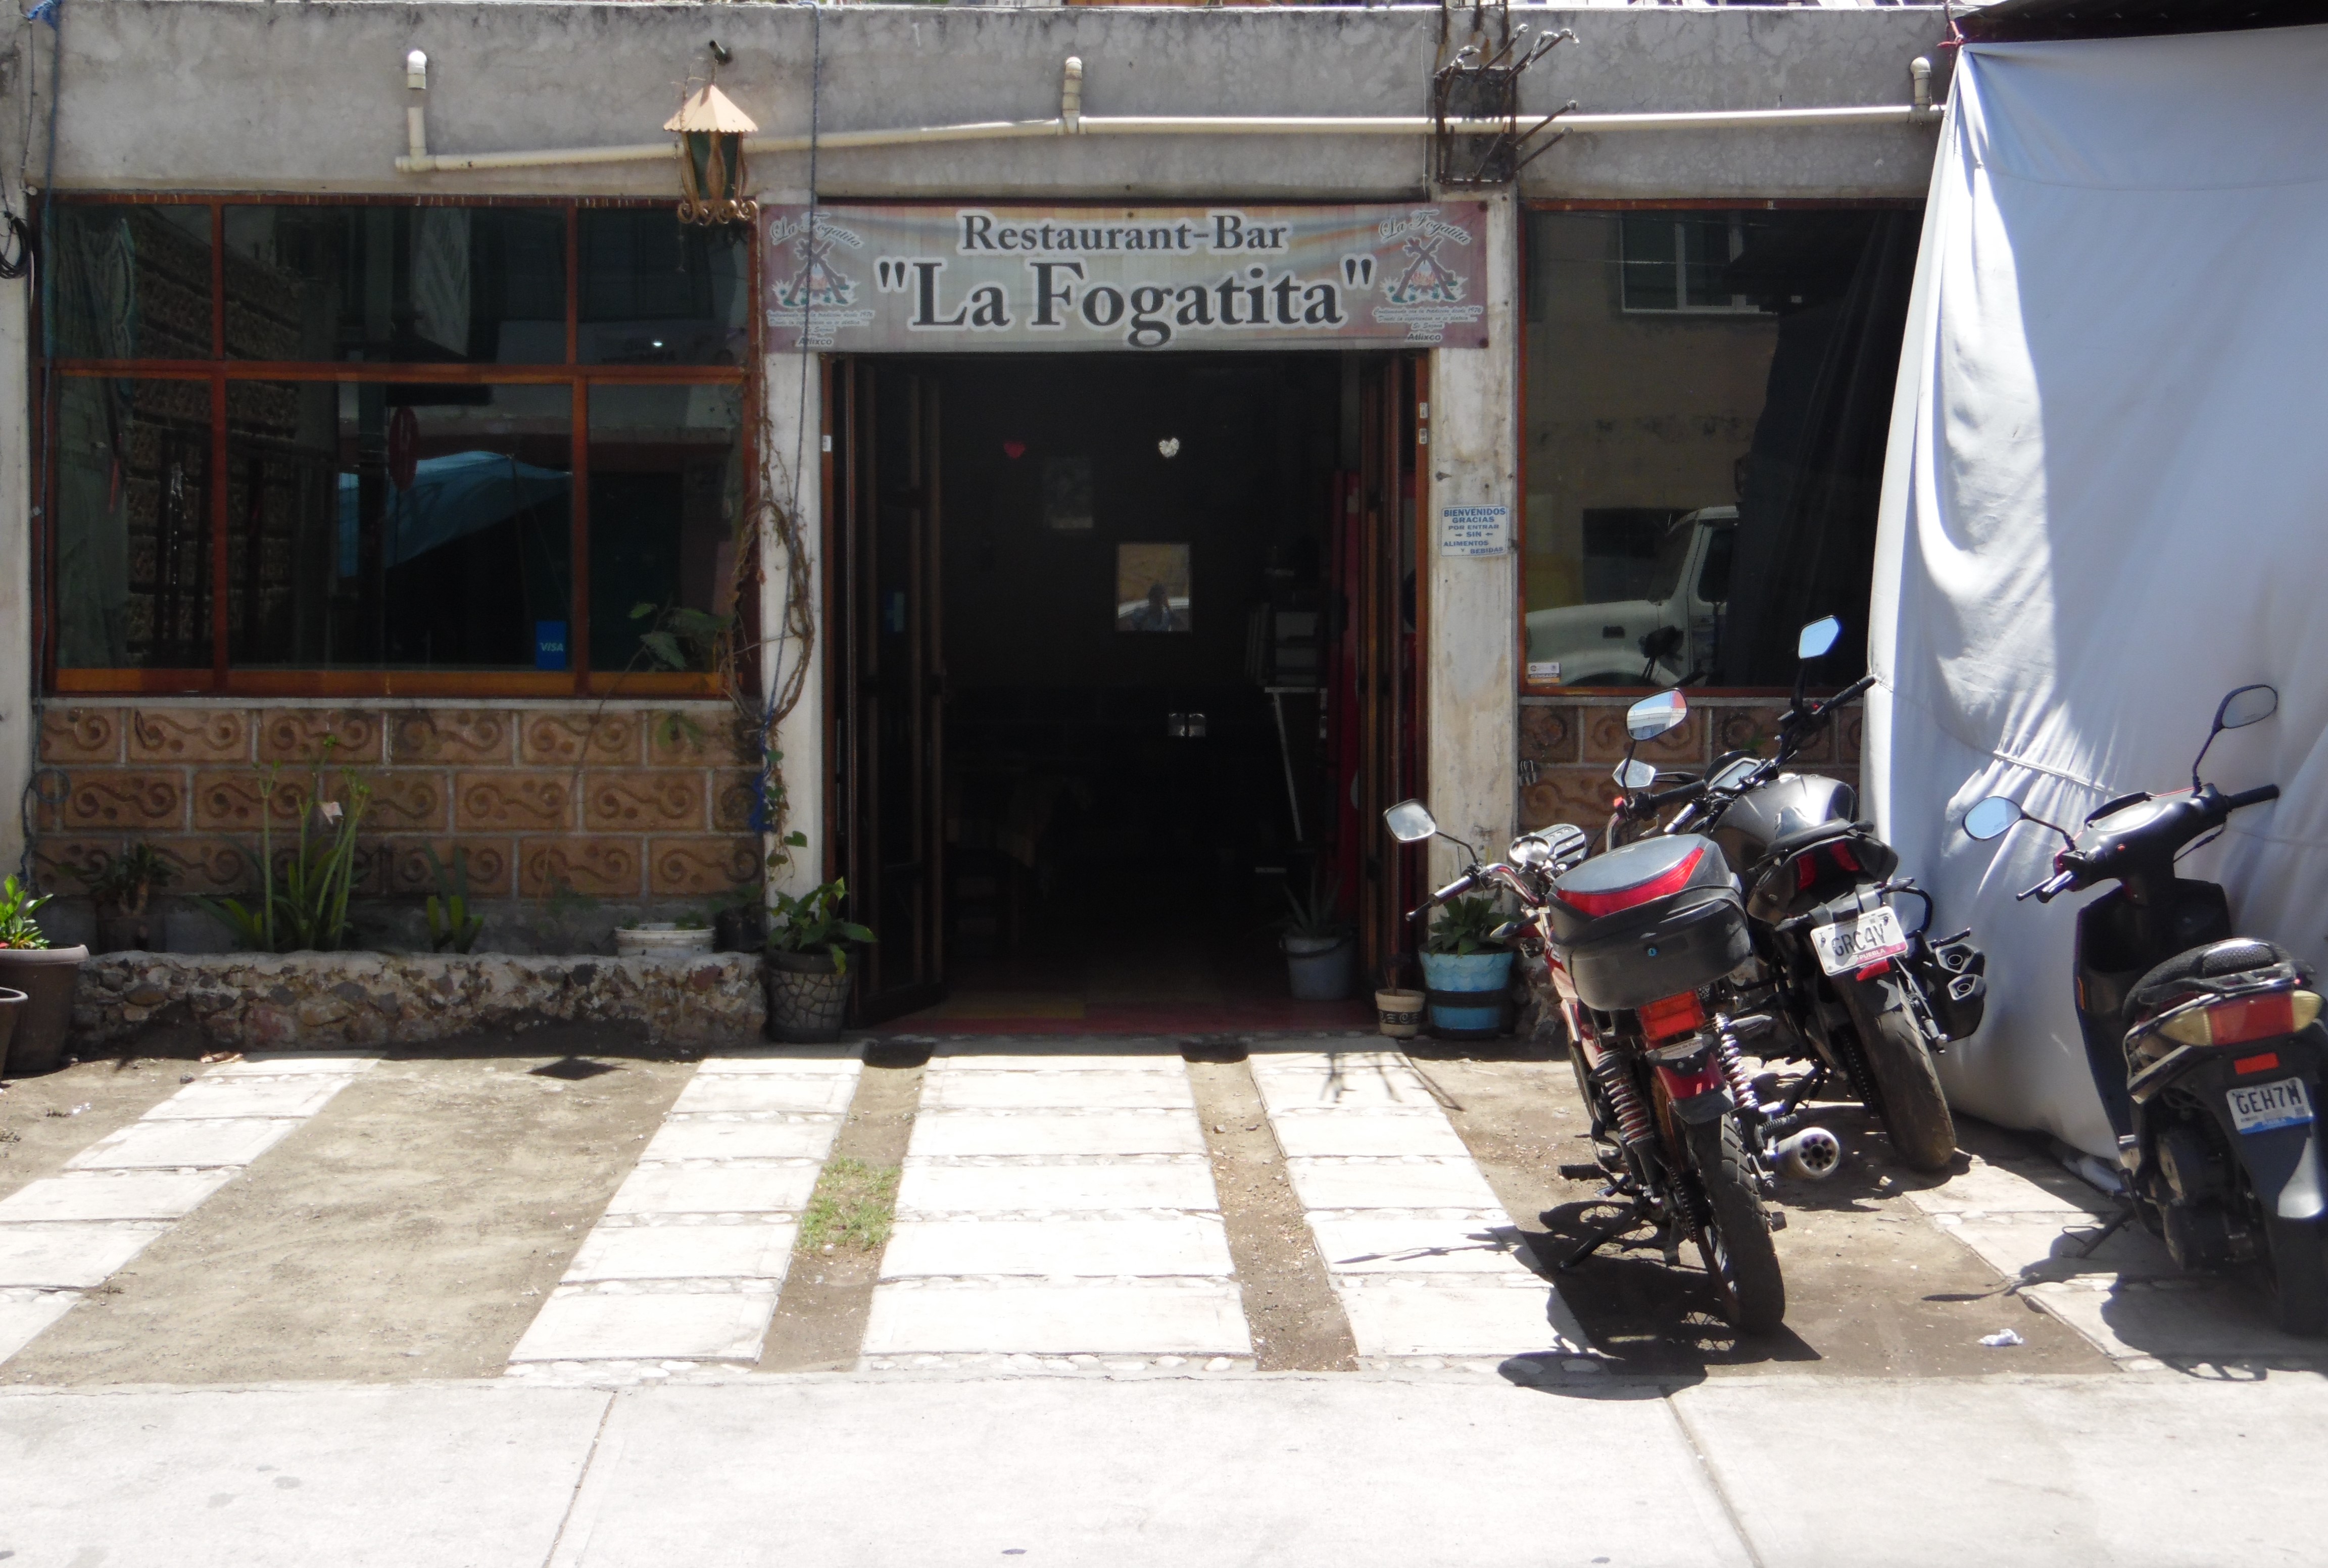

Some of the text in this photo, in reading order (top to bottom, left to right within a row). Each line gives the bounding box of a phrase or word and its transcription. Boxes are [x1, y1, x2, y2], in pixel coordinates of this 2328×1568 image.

[1380, 211, 1468, 242] La Fogatita
[1408, 333, 1441, 341] Atlixco
[1443, 508, 1506, 517] BIENVENIDOS
[540, 642, 564, 652] VISA
[1859, 949, 1886, 959] PUEBLA
